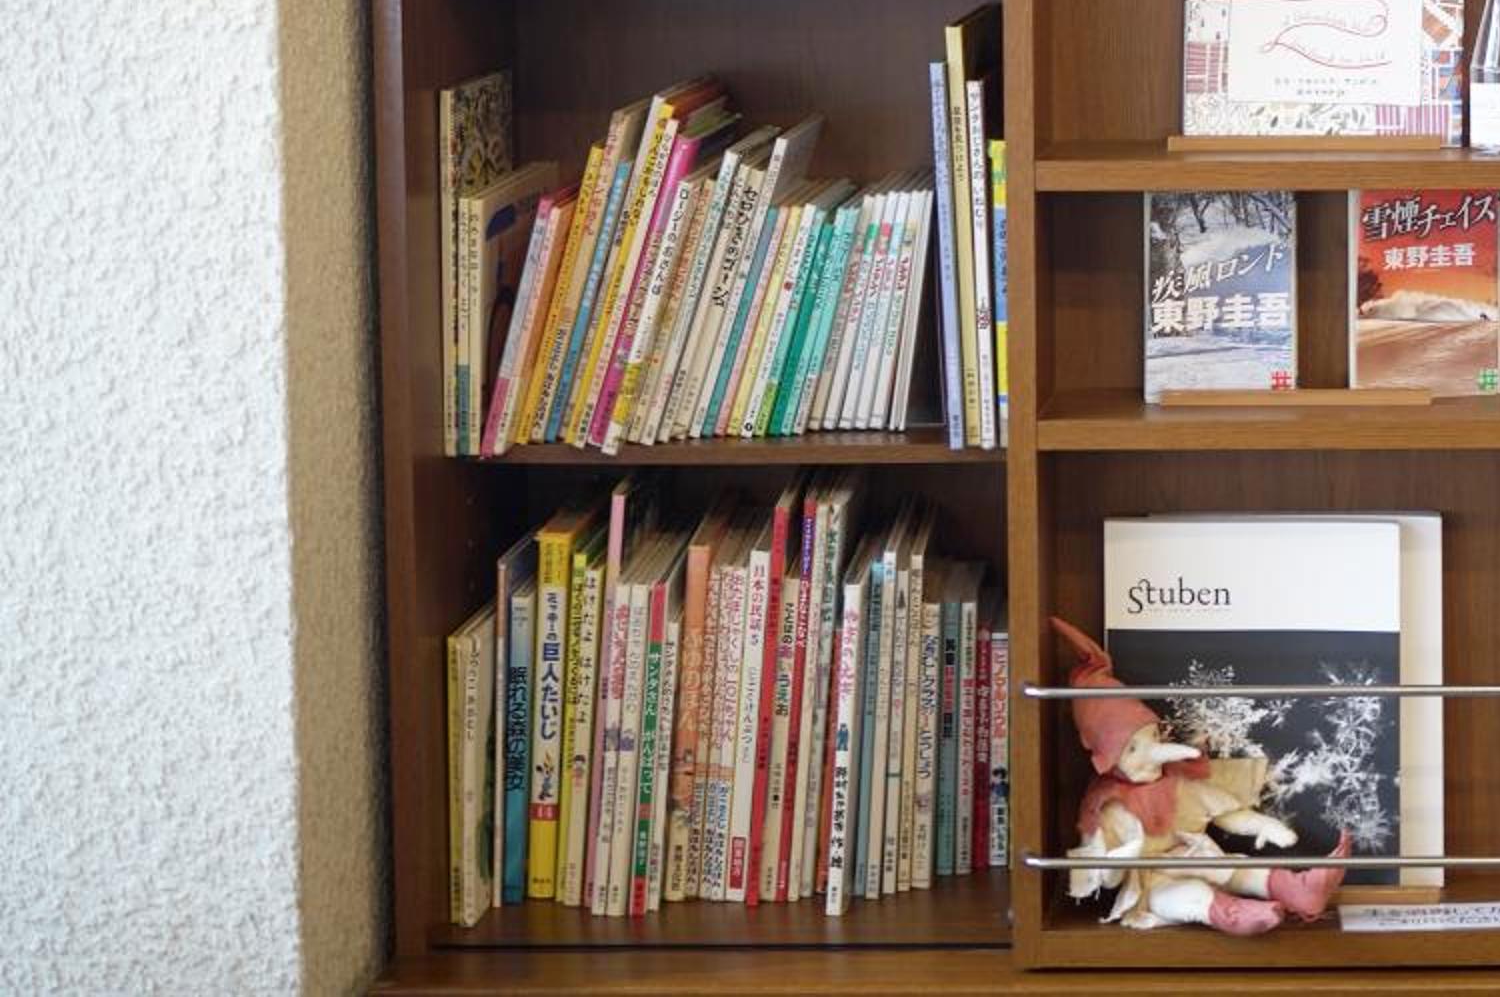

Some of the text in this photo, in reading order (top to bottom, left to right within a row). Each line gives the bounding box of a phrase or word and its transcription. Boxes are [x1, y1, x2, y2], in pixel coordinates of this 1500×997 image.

[711, 186, 758, 308] セロひきのゴーシュ
[1361, 193, 1497, 243] 雪煙チェイス
[1151, 242, 1286, 302] 疾風ロンド
[1383, 243, 1477, 271] 東野圭吾
[1150, 292, 1292, 335] 東野圭吾
[582, 575, 596, 643] はけたよ
[1127, 576, 1232, 614] Stuben
[540, 592, 561, 741] ミッキーの巨人たいじ
[577, 656, 592, 724] はけたよ
[506, 666, 527, 791] 眠れる森の美女
